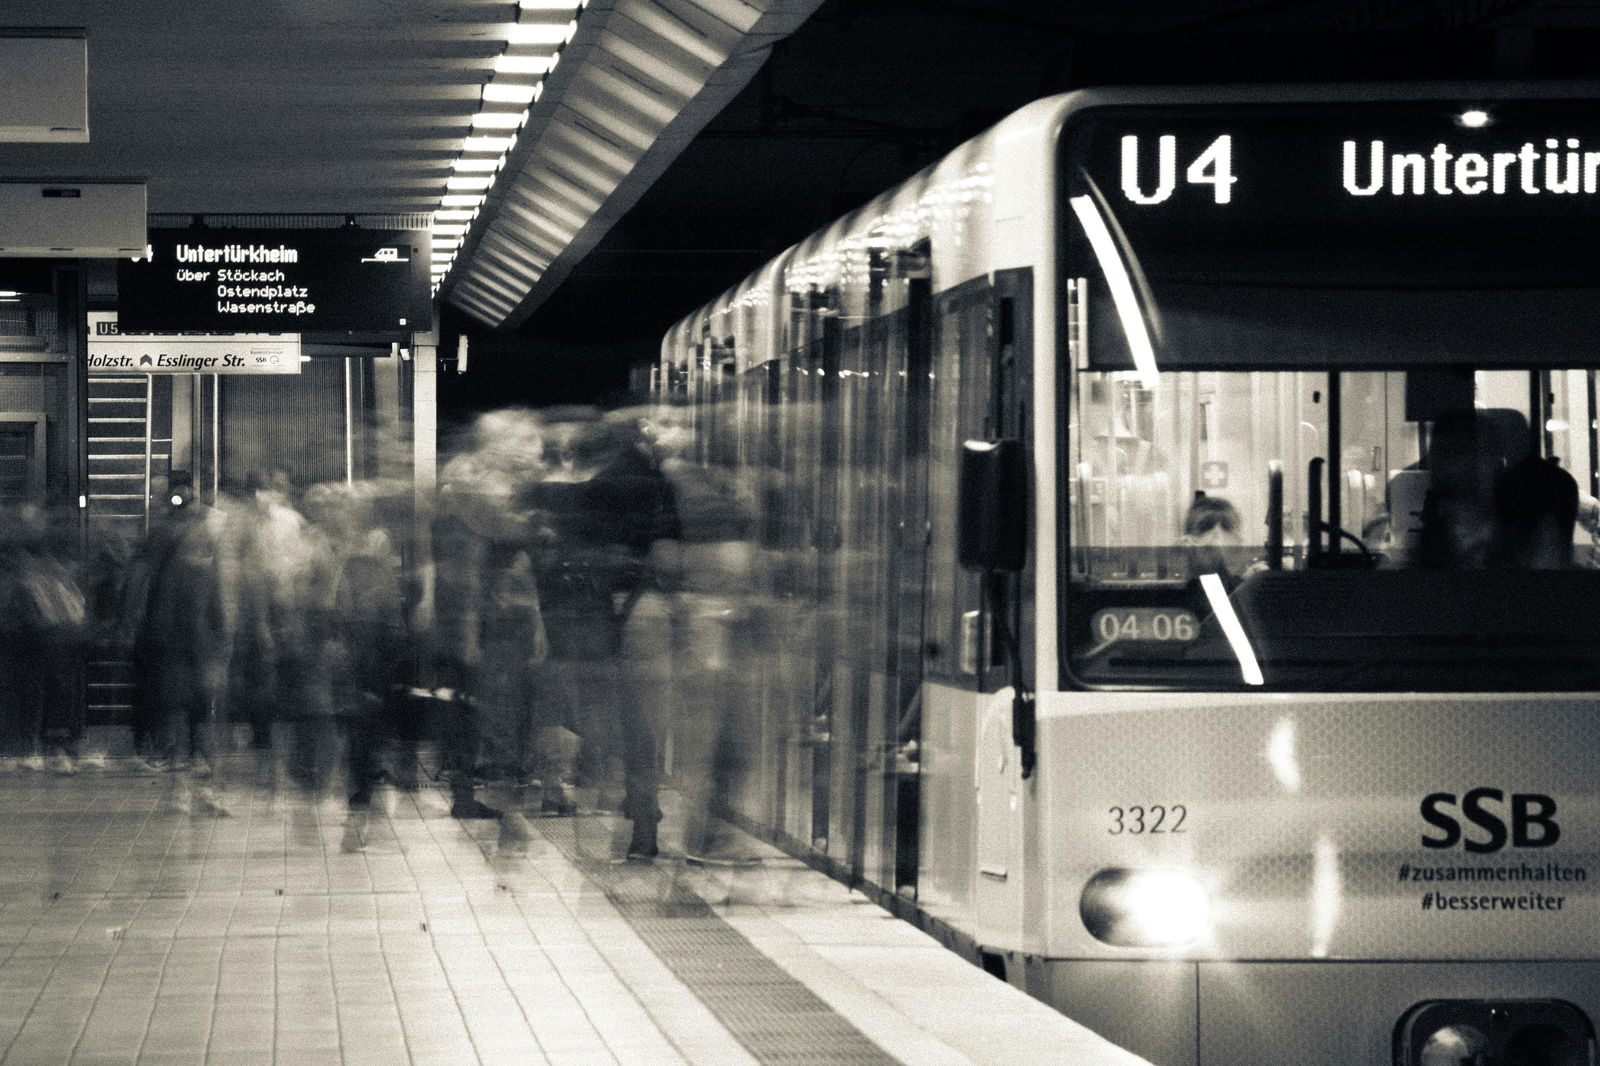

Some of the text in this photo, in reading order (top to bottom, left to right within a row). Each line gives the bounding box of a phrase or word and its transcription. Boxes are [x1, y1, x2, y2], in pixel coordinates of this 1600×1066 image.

[1121, 134, 1600, 204] U4 Untertür
[176, 244, 298, 263] Untertürkheim
[176, 269, 285, 281] über Stöckach
[217, 285, 308, 300] Ostendplatz
[217, 301, 316, 316] Wasenstraße
[157, 354, 218, 370] Esslinger
[222, 354, 245, 367] Str.
[1100, 614, 1193, 640] 04 06
[1108, 805, 1187, 836] 3322
[1420, 787, 1561, 853] SSB
[1398, 863, 1586, 882] #zusammenhalten
[1422, 891, 1566, 910] #besserweiter
